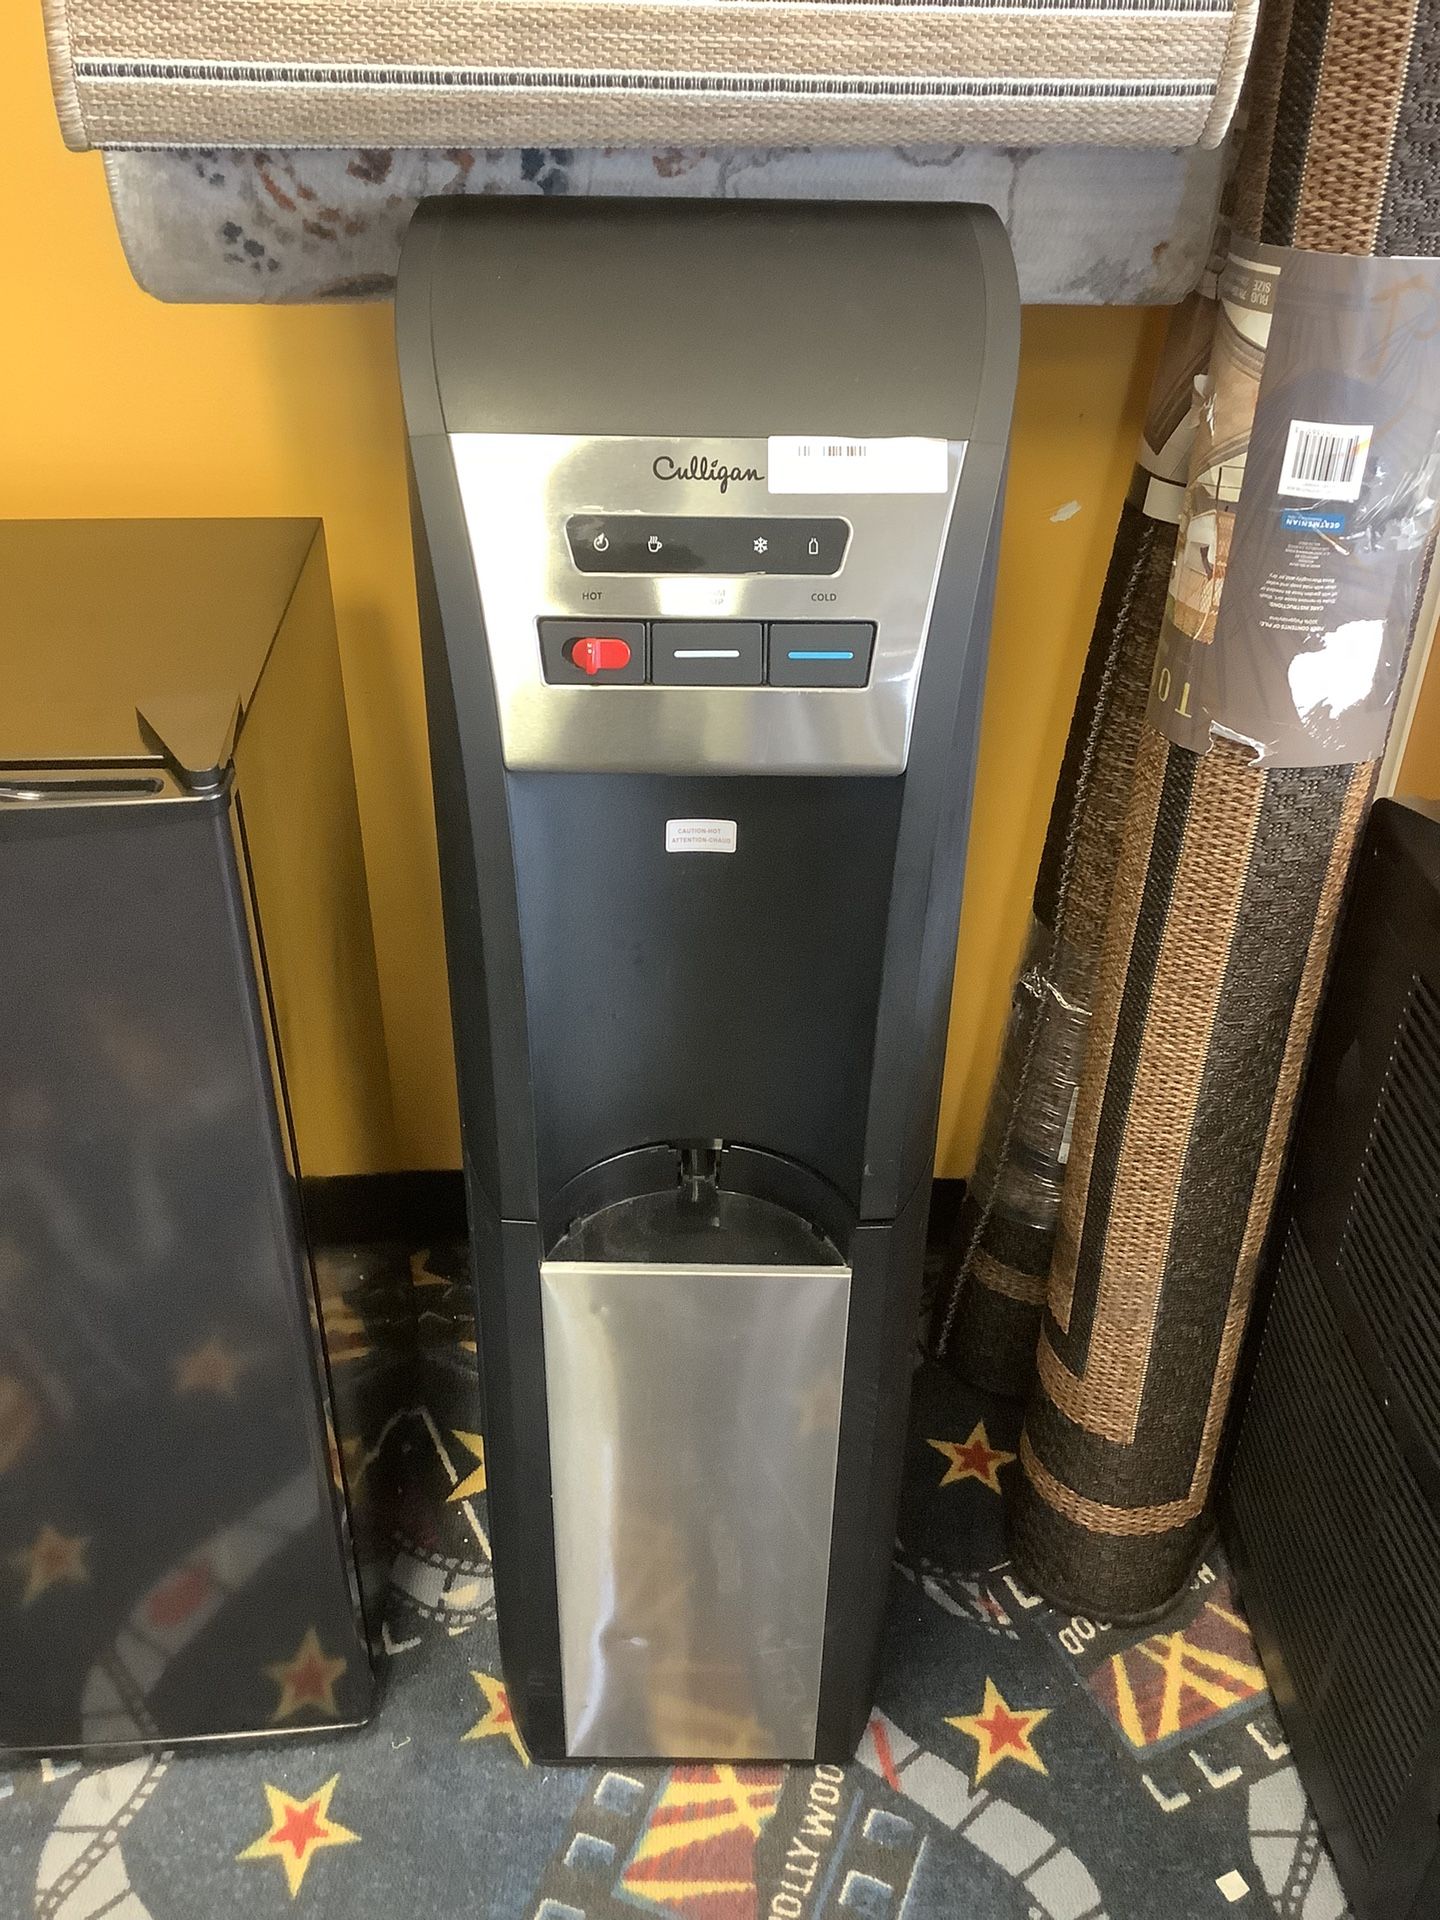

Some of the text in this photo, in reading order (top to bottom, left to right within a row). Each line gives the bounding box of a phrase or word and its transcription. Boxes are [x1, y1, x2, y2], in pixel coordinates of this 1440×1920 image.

[652, 456, 766, 494] Culligan
[582, 591, 603, 600] HOT
[811, 593, 837, 602] COLD
